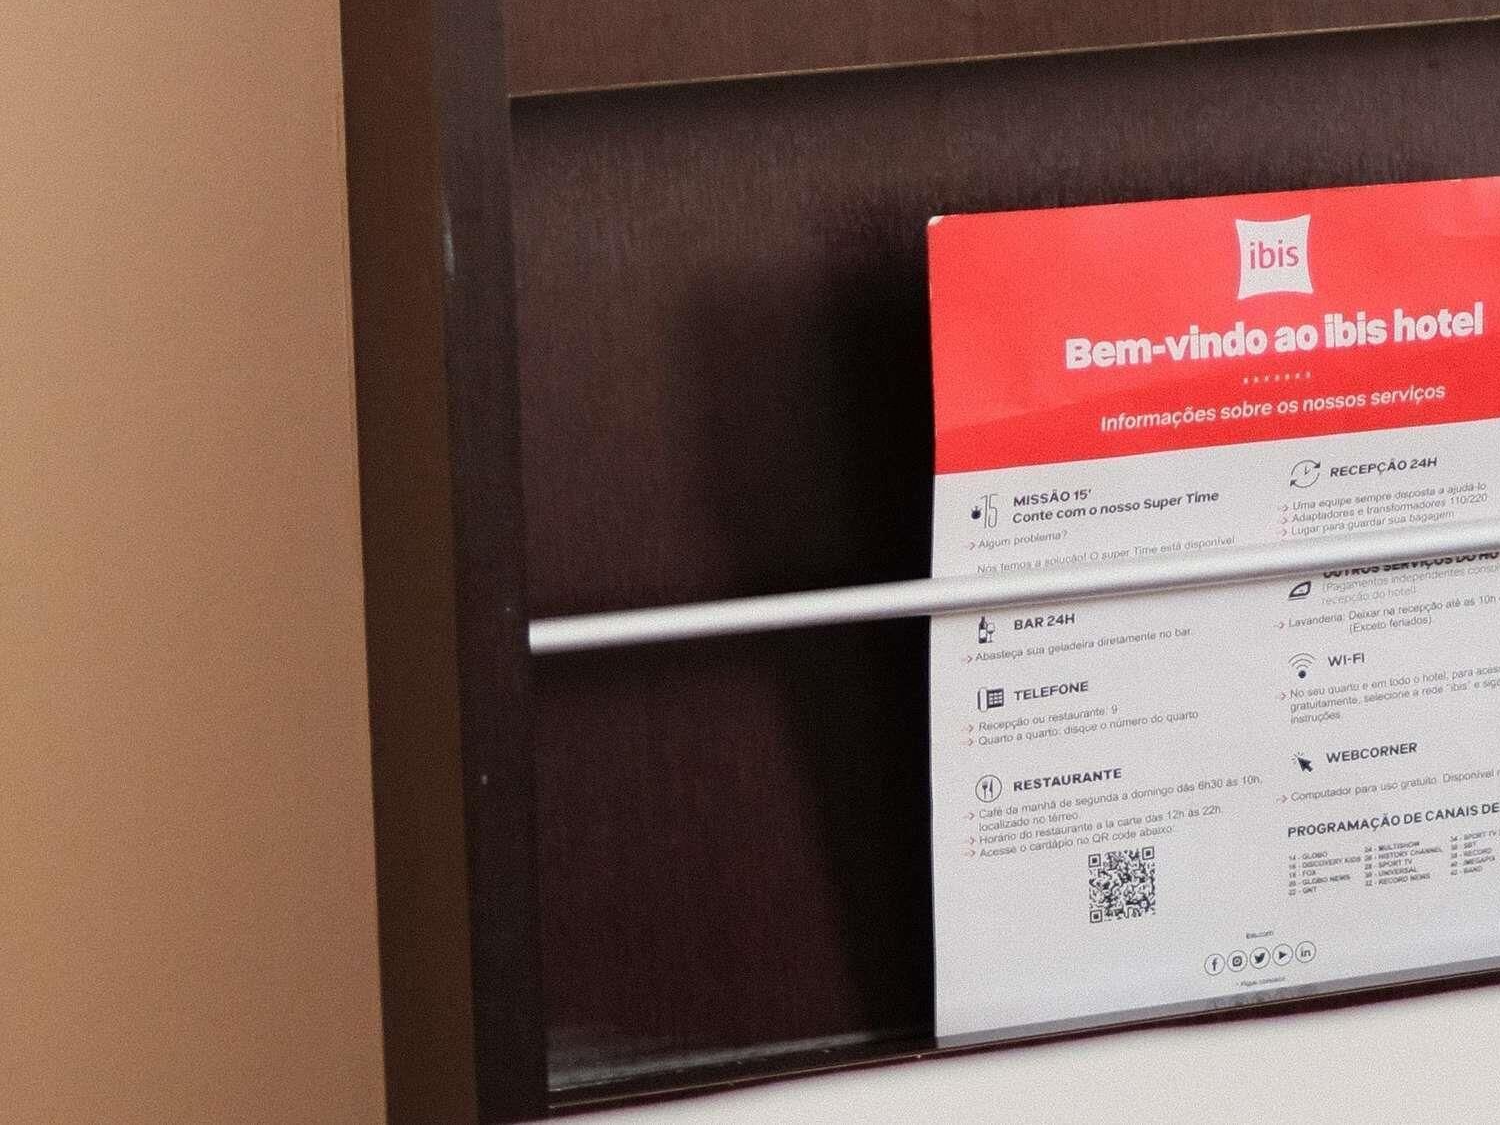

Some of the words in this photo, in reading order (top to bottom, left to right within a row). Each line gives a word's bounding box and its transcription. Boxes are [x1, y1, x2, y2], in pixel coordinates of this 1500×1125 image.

[1250, 239, 1299, 269] ibis
[1065, 321, 1268, 369] Bem-vindo
[1274, 325, 1318, 353] ao
[1324, 311, 1388, 348] ibis
[1393, 301, 1484, 342] hotel
[1101, 404, 1216, 432] Informações
[1220, 399, 1272, 419] sobre
[1277, 400, 1298, 413] os
[1302, 392, 1366, 412] nossos
[1370, 384, 1446, 406] serviços
[1329, 460, 1407, 478] RECEPÇÃO
[1409, 456, 1438, 470] 24H
[1012, 508, 1053, 524] Conte
[1056, 507, 1086, 520] com
[1089, 506, 1098, 516] o
[1099, 501, 1140, 516] nosso
[1143, 497, 1182, 513] Super
[1185, 490, 1220, 505] Time
[1013, 489, 1070, 507] MISSÃO
[1291, 508, 1355, 525] Adaptadores
[1356, 508, 1364, 516] e
[1366, 499, 1446, 515] transformadores
[1450, 493, 1488, 506] 110/220
[1292, 499, 1317, 511] Uma
[1318, 496, 1351, 510] equipe
[1355, 492, 1392, 506] sempre
[1290, 524, 1320, 538] Lugar
[1322, 520, 1346, 534] para
[1348, 517, 1386, 531] guardar
[1387, 515, 1407, 525] sua
[1409, 509, 1455, 525] bagagem
[978, 536, 1012, 552] Algum
[1013, 529, 1068, 546] problema?
[1013, 618, 1044, 630] BAR
[1047, 613, 1075, 627] 24H
[1348, 607, 1381, 622] Deixar
[1398, 600, 1444, 616] recepção
[975, 649, 1024, 661] Abasteça
[1026, 646, 1045, 656] sua
[1048, 639, 1095, 655] geladeira
[1097, 632, 1156, 648] diretamente
[1159, 631, 1173, 640] no
[1327, 652, 1365, 667] WI-FI
[1013, 681, 1089, 701] TELEFONE
[1290, 688, 1304, 699] No
[1306, 687, 1325, 697] seu
[1327, 682, 1360, 698] quarto
[1371, 680, 1388, 690] em
[1389, 675, 1411, 687] todo
[1451, 668, 1474, 682] para
[1363, 690, 1410, 705] selecione
[1421, 684, 1444, 696] rede
[978, 716, 1030, 732] Recepção
[1032, 716, 1046, 725] ou
[1111, 704, 1119, 715] 9
[978, 733, 1014, 747] Quarto
[1063, 722, 1098, 737] disque
[1109, 714, 1148, 730] número
[1150, 712, 1163, 724] do
[1165, 709, 1199, 725] quarto
[1326, 742, 1418, 763] WEBCORNER
[1013, 768, 1123, 792] RESTAURANTE
[1290, 786, 1351, 802] Computador
[1354, 783, 1378, 797] para
[1380, 781, 1398, 791] uso
[978, 808, 1001, 820] Café
[1005, 805, 1019, 816] da
[1059, 797, 1073, 809] de
[1075, 792, 1120, 808] segunda
[1130, 786, 1175, 803] domingo
[1197, 779, 1224, 791] 6h30
[978, 817, 1030, 832] localizado
[1032, 815, 1046, 825] no
[979, 831, 1017, 845] Horário
[1018, 829, 1033, 840] do
[1034, 823, 1094, 838] restaurante
[1166, 808, 1186, 820] 12h
[1287, 815, 1401, 837] PROGRAMAÇÃO
[1403, 812, 1423, 825] DE
[1425, 805, 1478, 822] CANAIS
[1481, 802, 1500, 814] DE
[979, 846, 1017, 858] Acesse
[1076, 838, 1090, 847] no
[1092, 832, 1110, 845] QR
[1112, 829, 1137, 841] code
